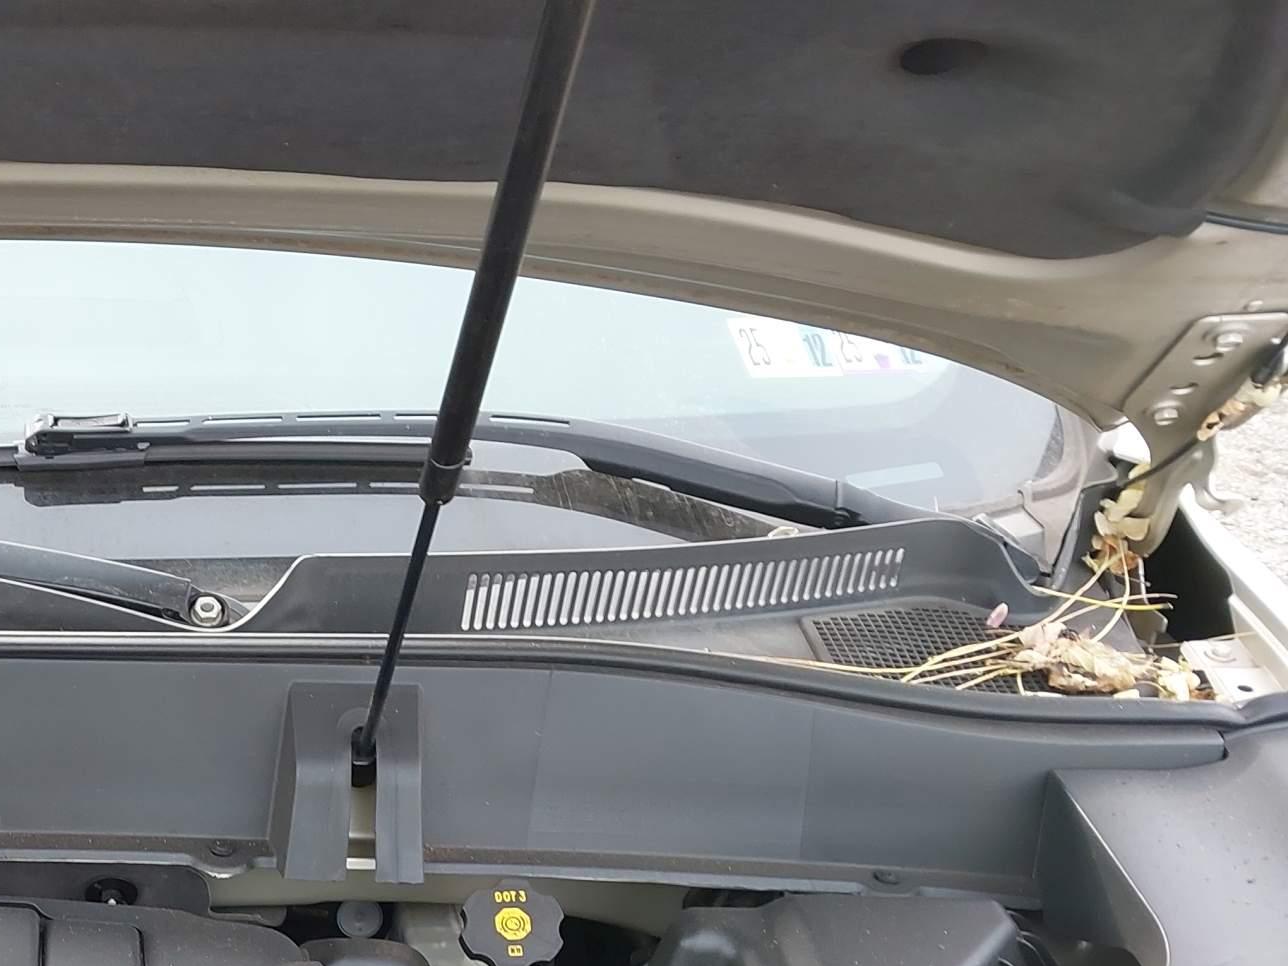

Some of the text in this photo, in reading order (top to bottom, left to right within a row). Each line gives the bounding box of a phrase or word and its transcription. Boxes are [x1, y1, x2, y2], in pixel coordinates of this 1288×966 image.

[738, 327, 772, 366] 25
[802, 333, 833, 367] 12
[494, 890, 527, 903] DOT 3
